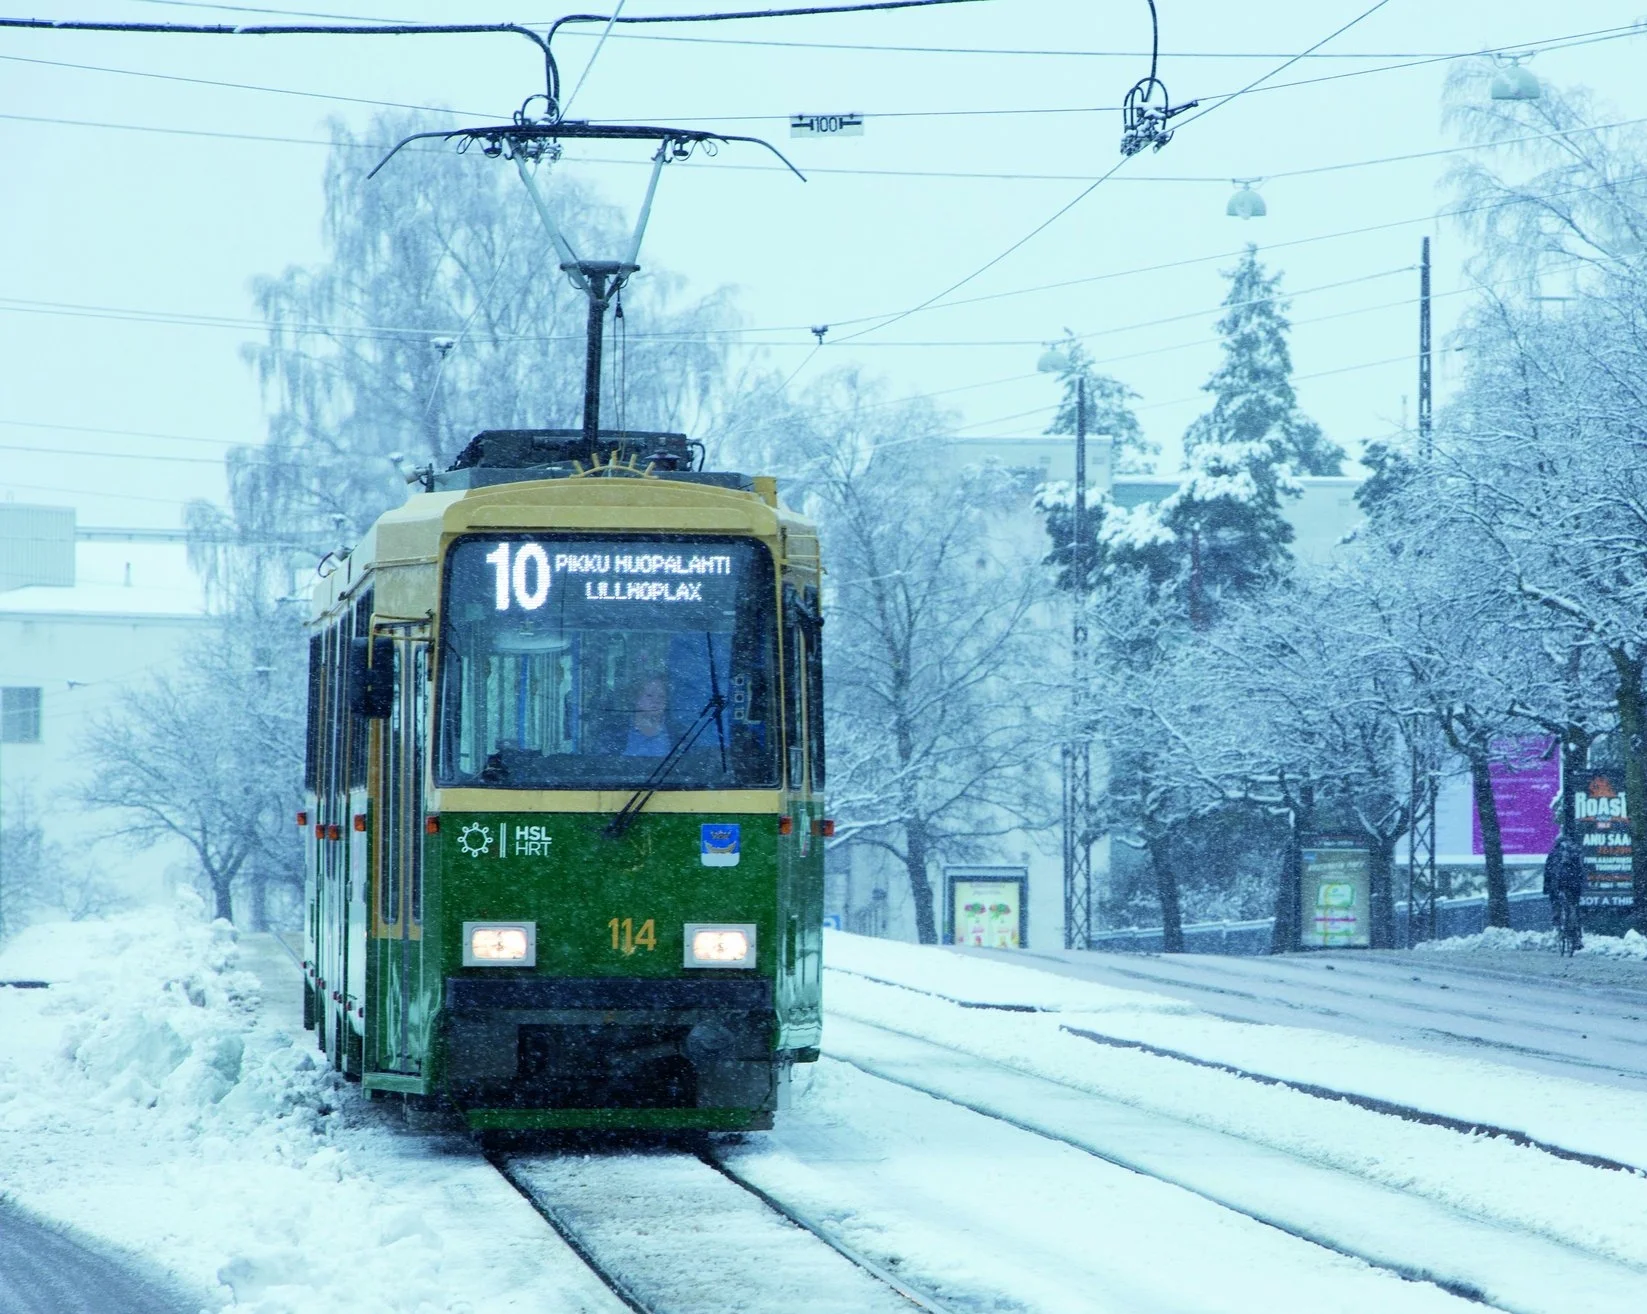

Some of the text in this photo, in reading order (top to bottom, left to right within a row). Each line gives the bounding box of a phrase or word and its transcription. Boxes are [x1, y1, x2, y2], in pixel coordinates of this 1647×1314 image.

[815, 116, 837, 132] 100
[555, 553, 731, 575] PIKKU HUOPALAHTI
[486, 542, 551, 611] 10
[584, 581, 703, 601] LILLHOPLAX
[516, 826, 552, 841] HSL
[516, 841, 552, 856] HRT
[608, 917, 657, 952] 114
